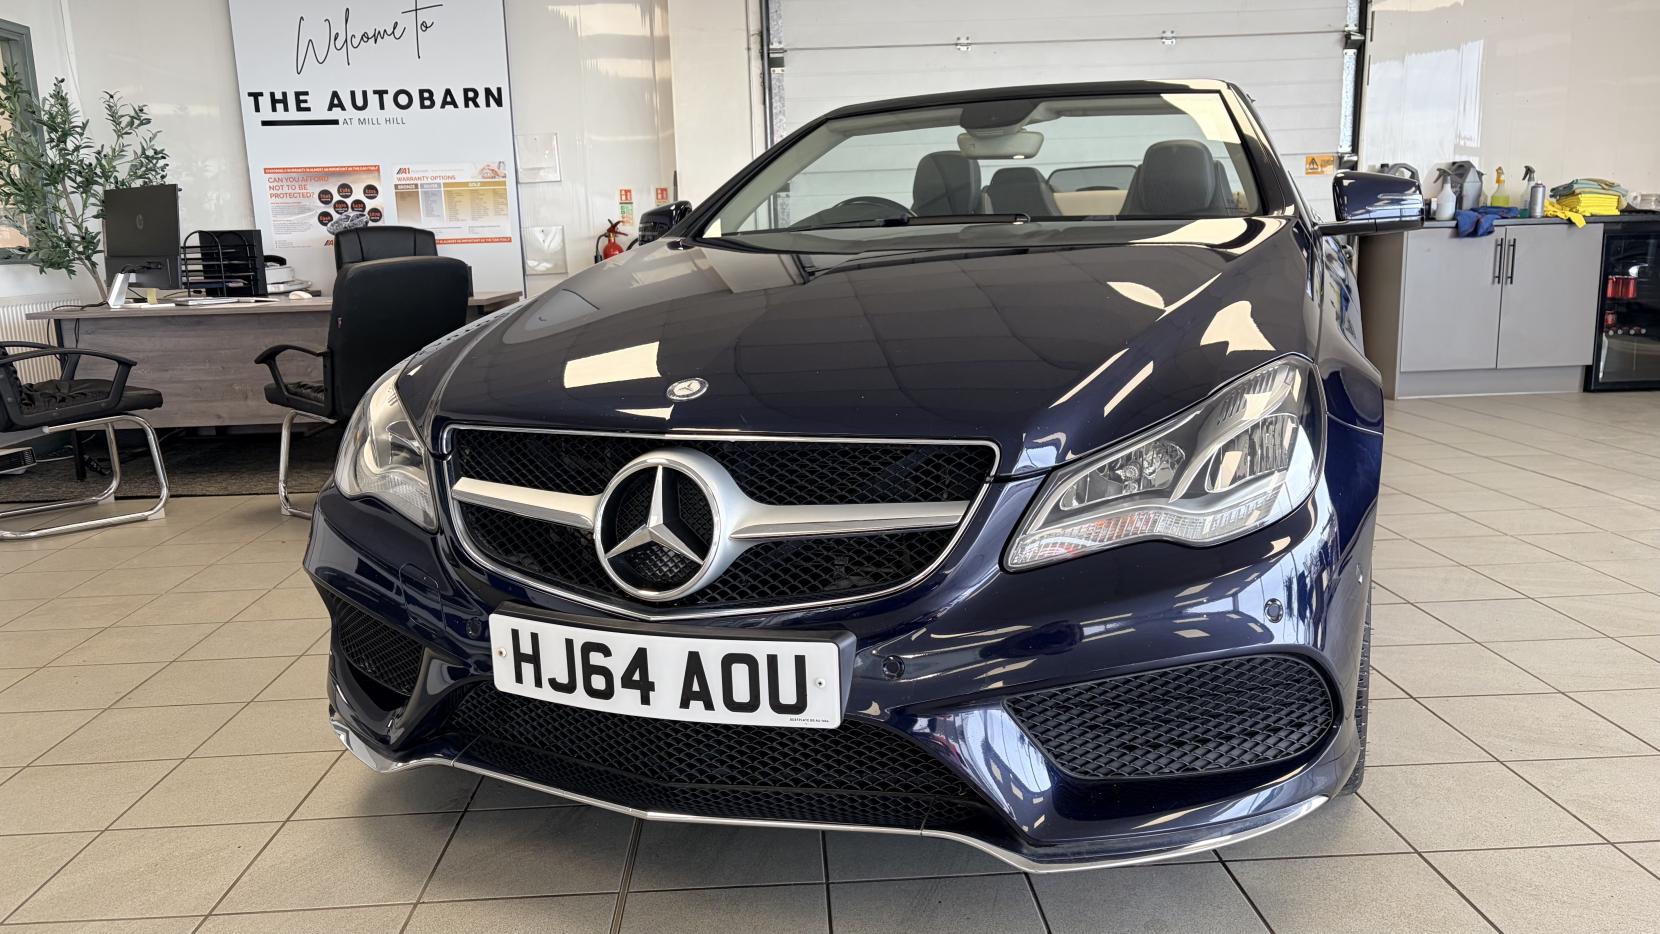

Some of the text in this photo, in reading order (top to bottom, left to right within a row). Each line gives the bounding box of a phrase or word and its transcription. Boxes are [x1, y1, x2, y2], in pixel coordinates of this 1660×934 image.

[296, 8, 406, 75] Welcome
[247, 87, 503, 113] THE AUTOBARN
[342, 117, 406, 126] AT MILL HILL
[511, 628, 808, 716] HJ64 AOU
